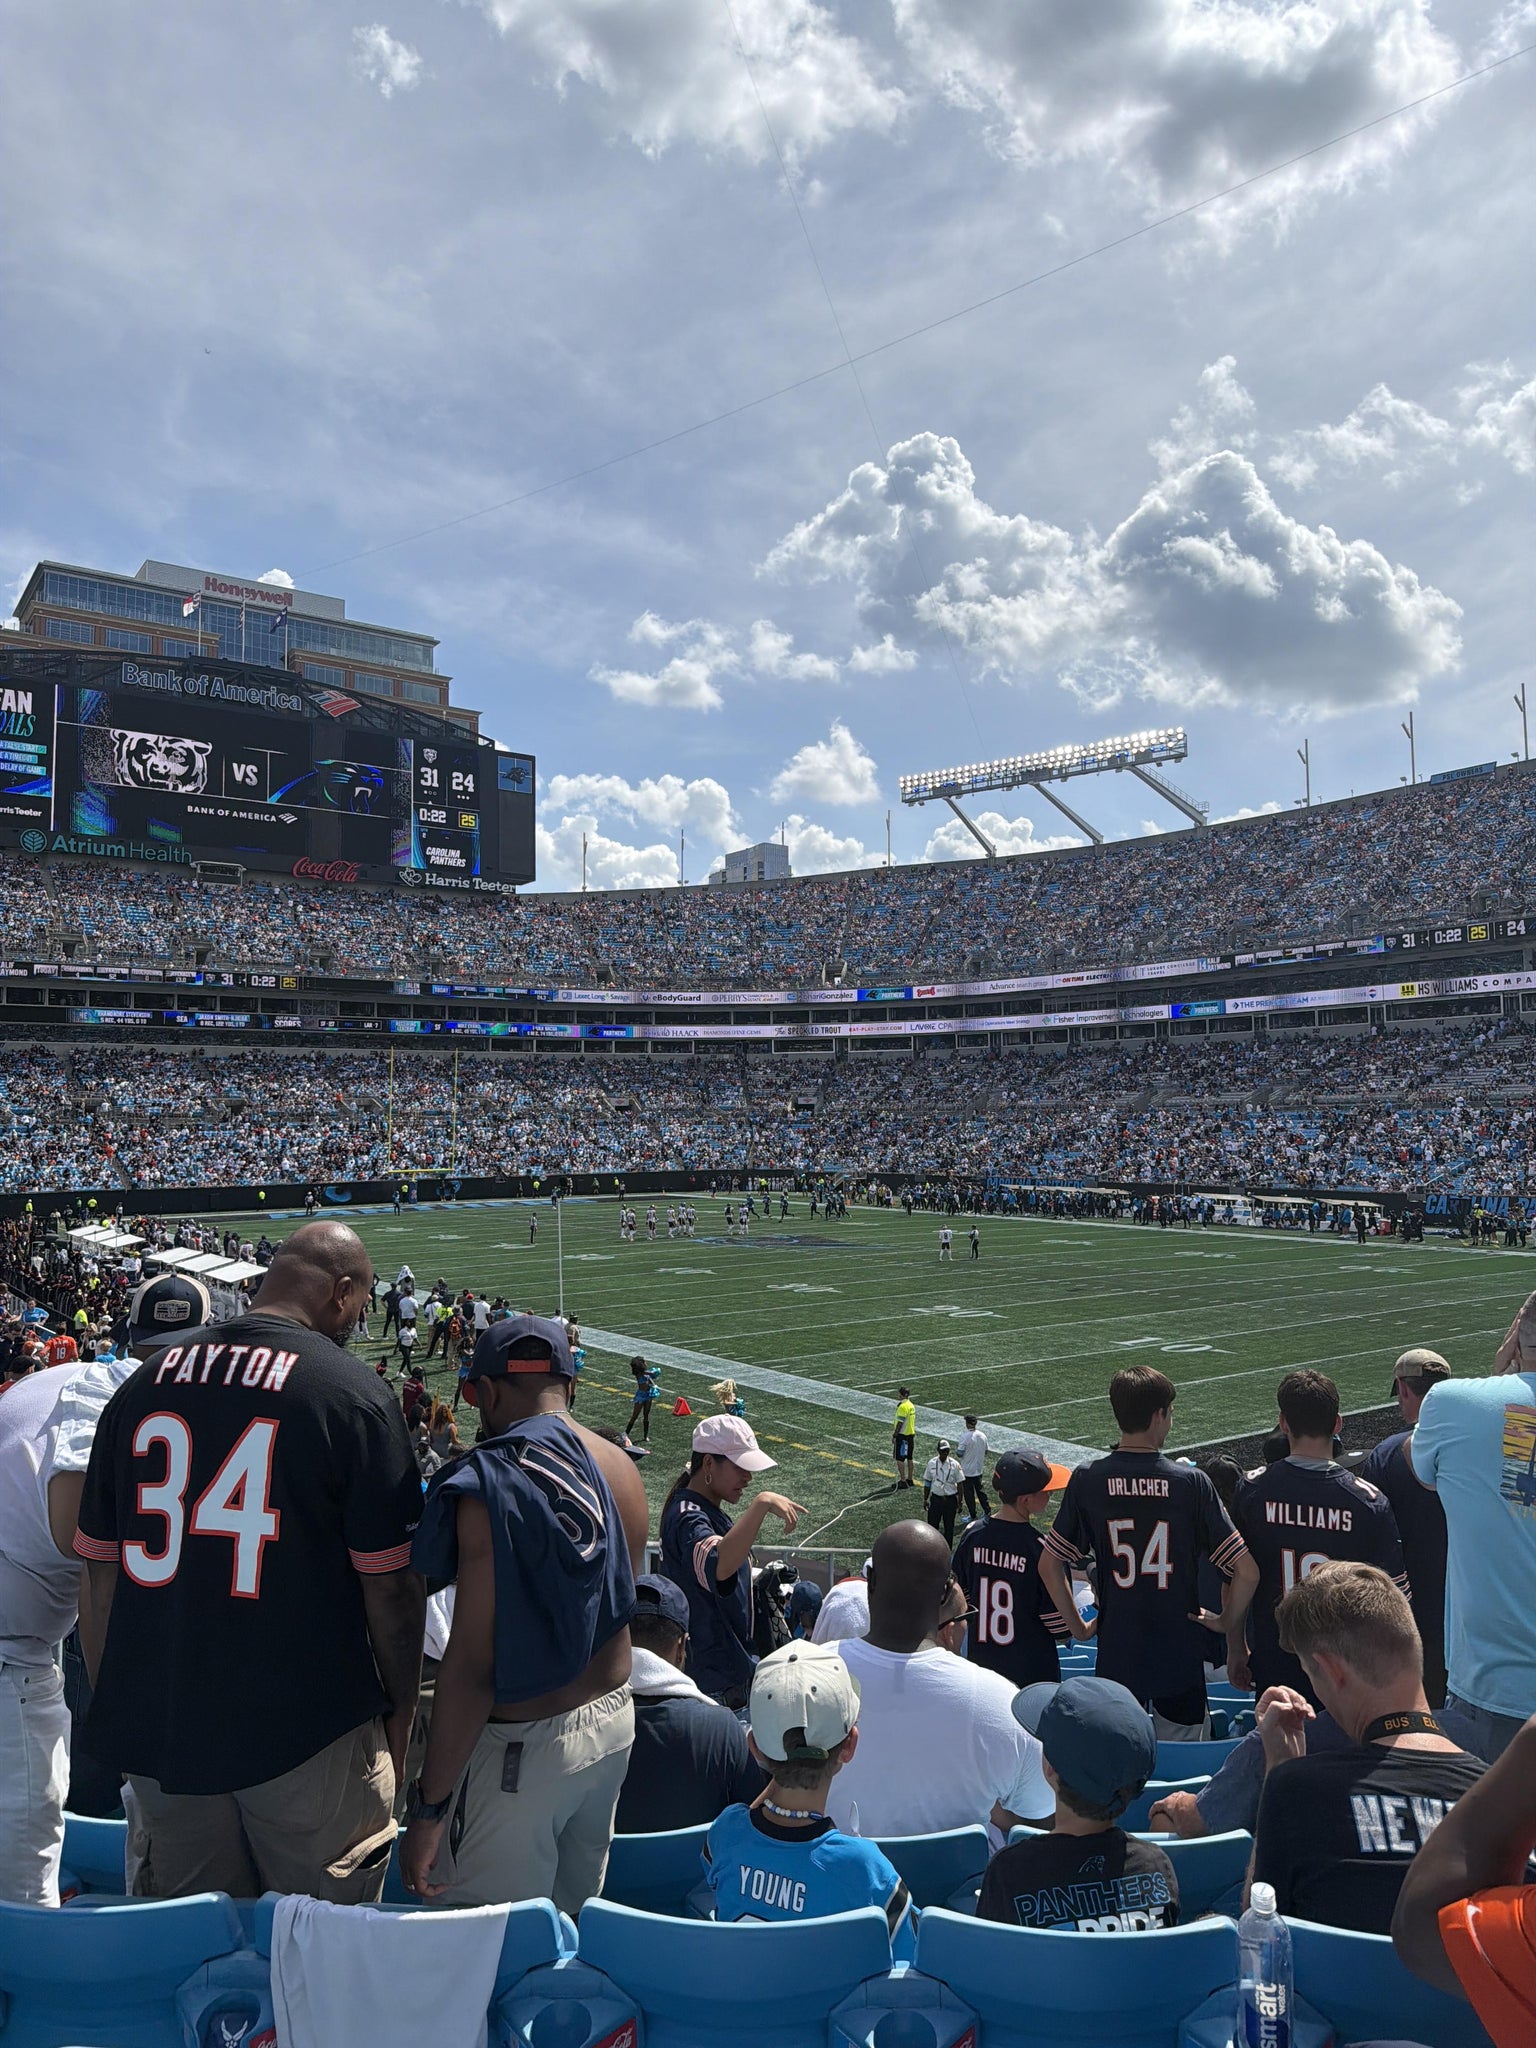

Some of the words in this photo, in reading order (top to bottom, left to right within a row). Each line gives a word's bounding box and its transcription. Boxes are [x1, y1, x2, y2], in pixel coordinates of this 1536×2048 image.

[204, 576, 293, 607] Honeywell
[121, 661, 183, 692] Bank
[184, 673, 208, 696] of
[210, 677, 302, 711] America
[0, 688, 32, 714] AN
[232, 762, 258, 788] VS
[420, 766, 439, 788] 31
[452, 771, 474, 793] 24
[14, 807, 42, 817] Teeter
[187, 804, 215, 816] BANK
[218, 807, 230, 817] OF
[232, 808, 276, 822] AMERICA
[419, 808, 446, 824] 0:22
[461, 814, 476, 827] 25
[52, 835, 126, 858] Atrium
[128, 842, 192, 864] Health
[426, 846, 460, 858] CAROLINA
[430, 856, 466, 868] PANTHERS
[425, 872, 470, 888] Harris
[472, 878, 516, 894] Teeter
[1434, 928, 1462, 944] 0:22
[1470, 926, 1486, 940] 25
[1506, 920, 1526, 936] 24
[1402, 933, 1416, 948] 31
[221, 973, 234, 986] 31
[252, 976, 276, 988] 0:22
[282, 978, 296, 988] 25
[1418, 983, 1430, 996] HS
[1430, 978, 1478, 994] WILLIAMS
[652, 994, 702, 1002] eBodyGuard
[1240, 1001, 1254, 1009] THE
[938, 1022, 952, 1030] CPA
[1054, 1014, 1074, 1023] Fisher
[1076, 1011, 1120, 1023] Improvement
[787, 1026, 820, 1036] SPECKLED
[820, 1026, 842, 1034] TROUT
[56, 1347, 66, 1360] 18
[153, 1343, 300, 1393] PAYTON
[1108, 1476, 1170, 1498] URLACHER
[122, 1411, 280, 1600] 34
[1264, 1500, 1352, 1532] WILLIAMS
[972, 1546, 1028, 1574] WILLIAMS
[1106, 1518, 1174, 1590] 54
[978, 1576, 1015, 1646] 18
[1350, 1794, 1456, 1852] NEW
[740, 1864, 806, 1913] YOUNG
[1013, 1872, 1171, 1926] PANTHERS
[1256, 1982, 1278, 2048] smart
